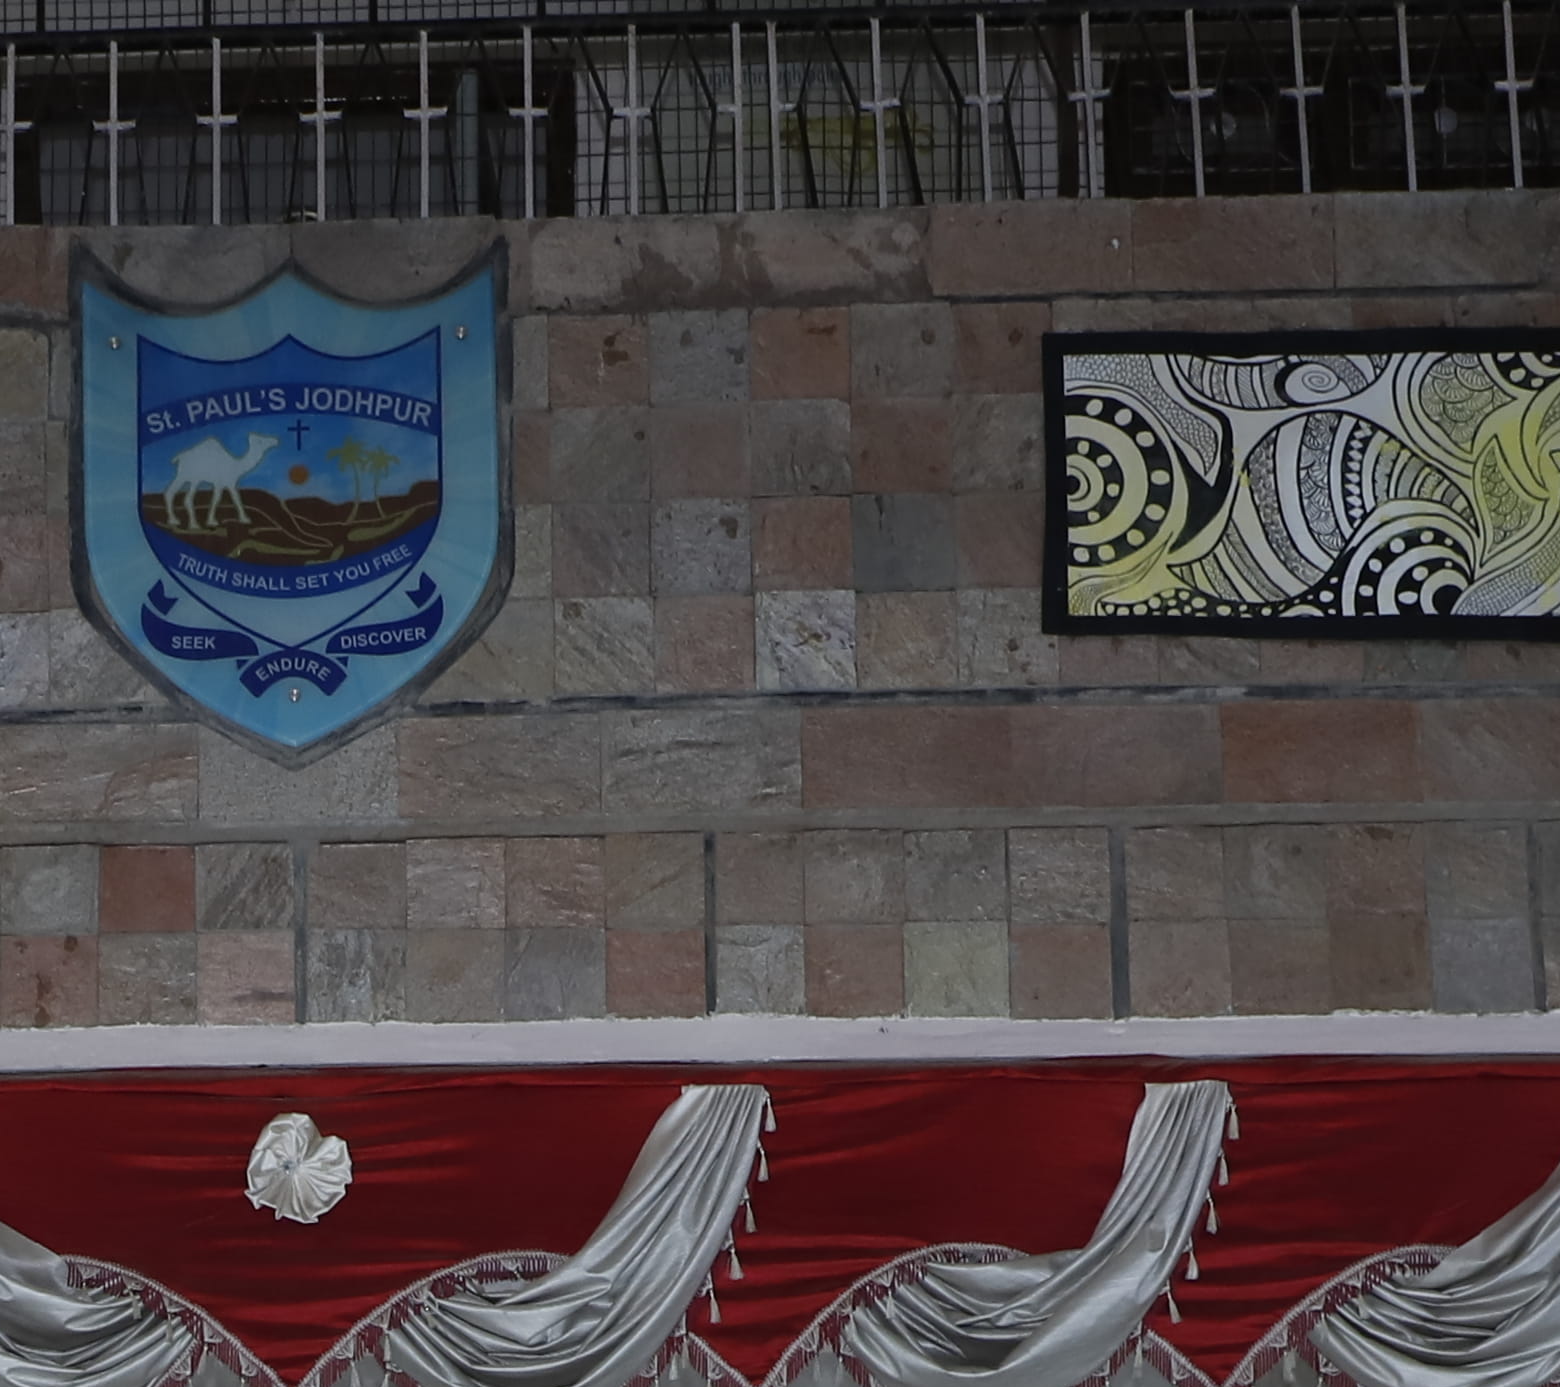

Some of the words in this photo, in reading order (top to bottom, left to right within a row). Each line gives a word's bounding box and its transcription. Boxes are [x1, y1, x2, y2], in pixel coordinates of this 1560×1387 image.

[146, 410, 181, 434] St.
[186, 387, 287, 424] PAUL'S
[294, 386, 432, 427] JODHPUR
[178, 552, 228, 584] TRUTH
[231, 571, 291, 591] SHALL
[295, 574, 330, 591] SET
[333, 562, 371, 584] YOU
[373, 543, 413, 571] FREE
[171, 635, 216, 650] SEEK
[339, 626, 428, 650] DISCOVER
[254, 656, 332, 683] ENDURE
